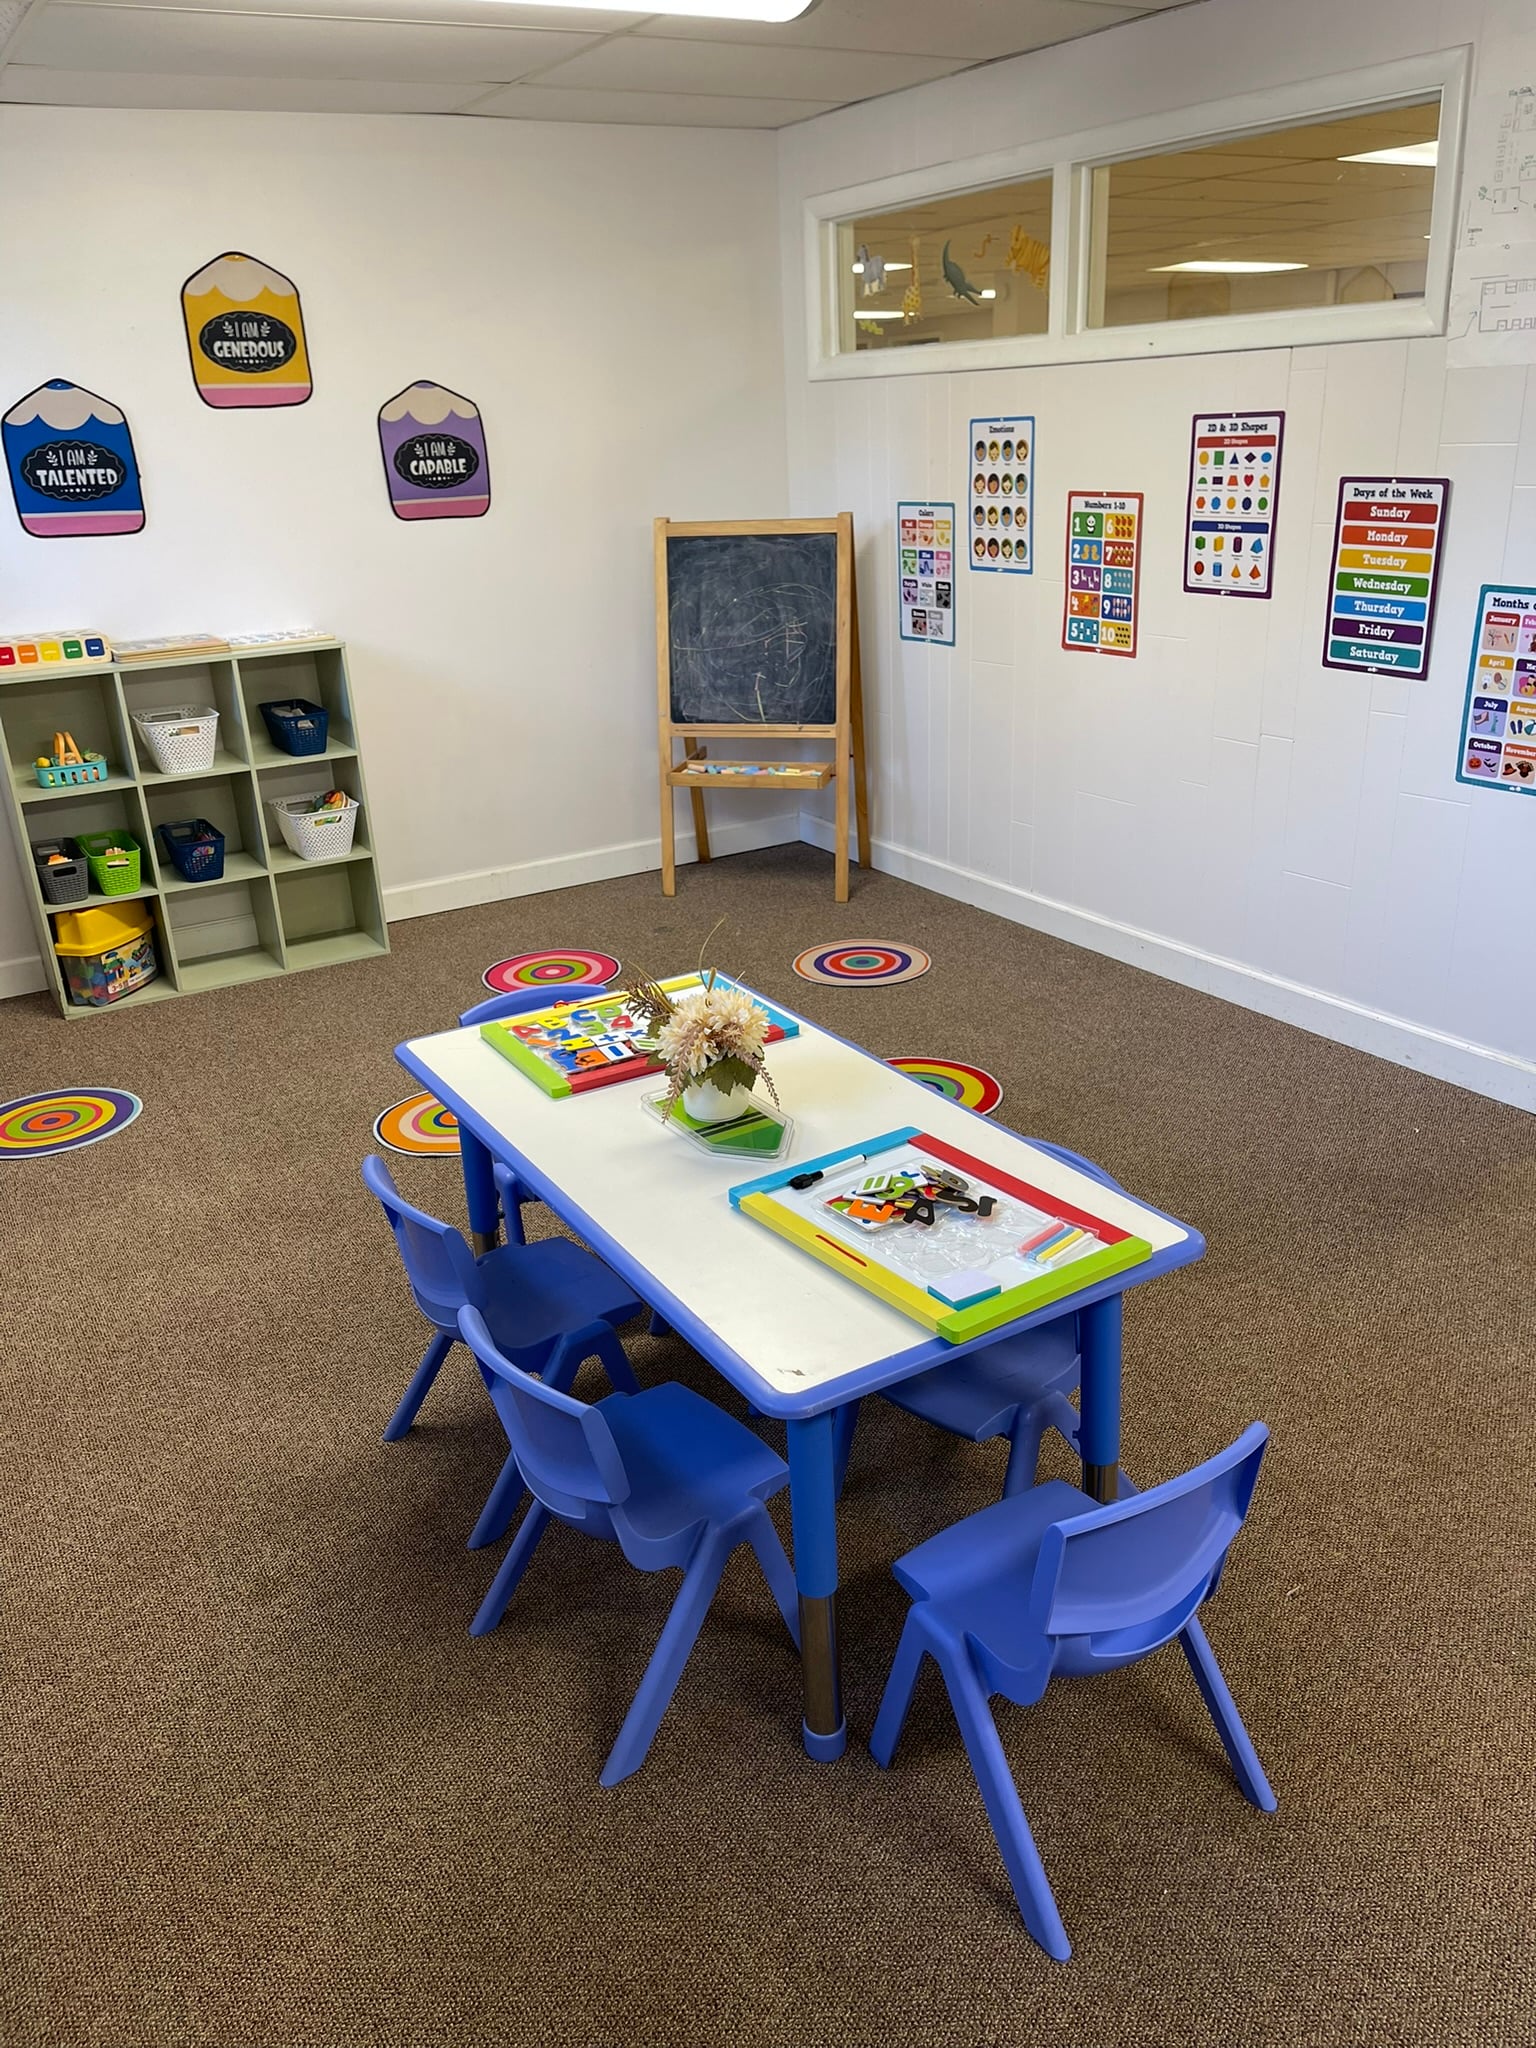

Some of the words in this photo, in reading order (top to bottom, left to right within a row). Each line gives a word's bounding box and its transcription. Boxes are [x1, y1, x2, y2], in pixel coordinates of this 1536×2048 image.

[234, 321, 240, 338] I
[241, 321, 259, 338] AM
[213, 340, 285, 358] GENEROUS
[1241, 422, 1268, 433] Shapes
[424, 442, 429, 457] I
[430, 441, 446, 457] AM
[59, 449, 64, 466] I
[67, 449, 86, 466] AM
[410, 458, 467, 476] CAPABLE
[36, 468, 118, 486] TALENTED
[1354, 488, 1376, 499] Days
[1378, 488, 1388, 497] of
[1392, 488, 1406, 497] the
[1410, 489, 1433, 499] Week
[1084, 501, 1112, 509] Numbers
[1370, 506, 1411, 521] Sunday
[1074, 517, 1081, 532] 1
[1106, 519, 1113, 534] 6
[1366, 530, 1408, 546] Monday
[1073, 544, 1080, 559] 2
[1106, 546, 1113, 561] 7
[1363, 554, 1408, 569] Tuesday
[1072, 570, 1080, 585] 3
[1104, 573, 1112, 589] 8
[1353, 578, 1412, 594] Wednesday
[1071, 596, 1079, 611] 4
[1103, 600, 1111, 615] 9
[1354, 600, 1405, 617] Thursday
[1493, 597, 1530, 609] Months
[1489, 615, 1517, 625] January
[1071, 623, 1078, 637] 5
[1101, 627, 1115, 643] 10
[1358, 624, 1395, 640] Friday
[1350, 646, 1399, 664] Saturday
[1484, 701, 1499, 710] July
[1473, 741, 1497, 751] October
